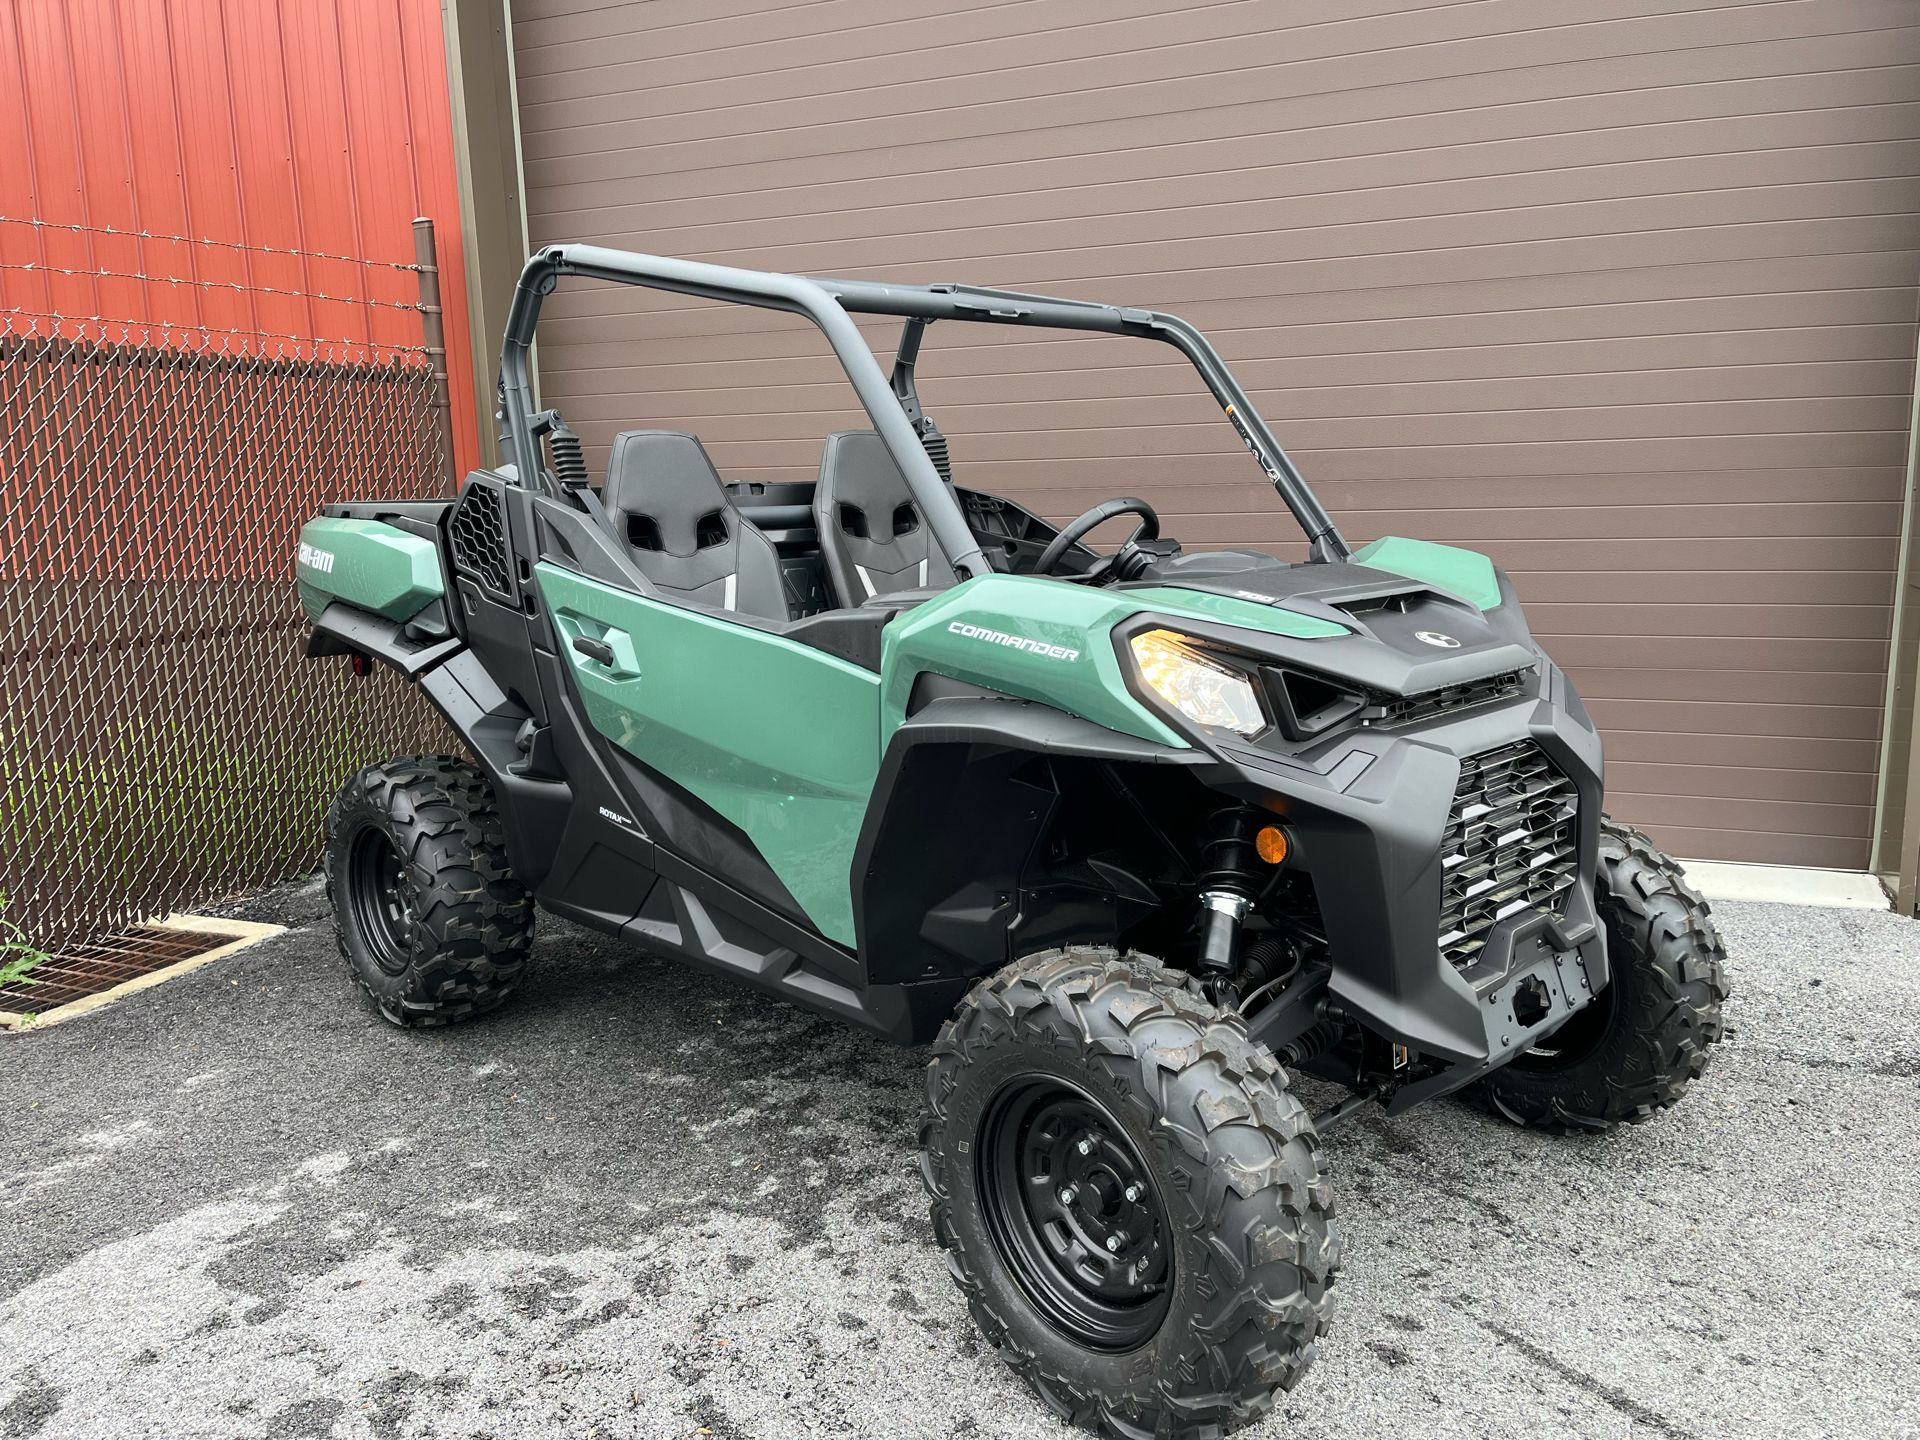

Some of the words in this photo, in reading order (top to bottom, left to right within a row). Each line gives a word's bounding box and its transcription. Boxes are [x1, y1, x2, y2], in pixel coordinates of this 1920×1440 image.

[1234, 590, 1275, 601] 700
[947, 621, 1080, 662] COMMANDER
[599, 806, 622, 824] ROTAX
